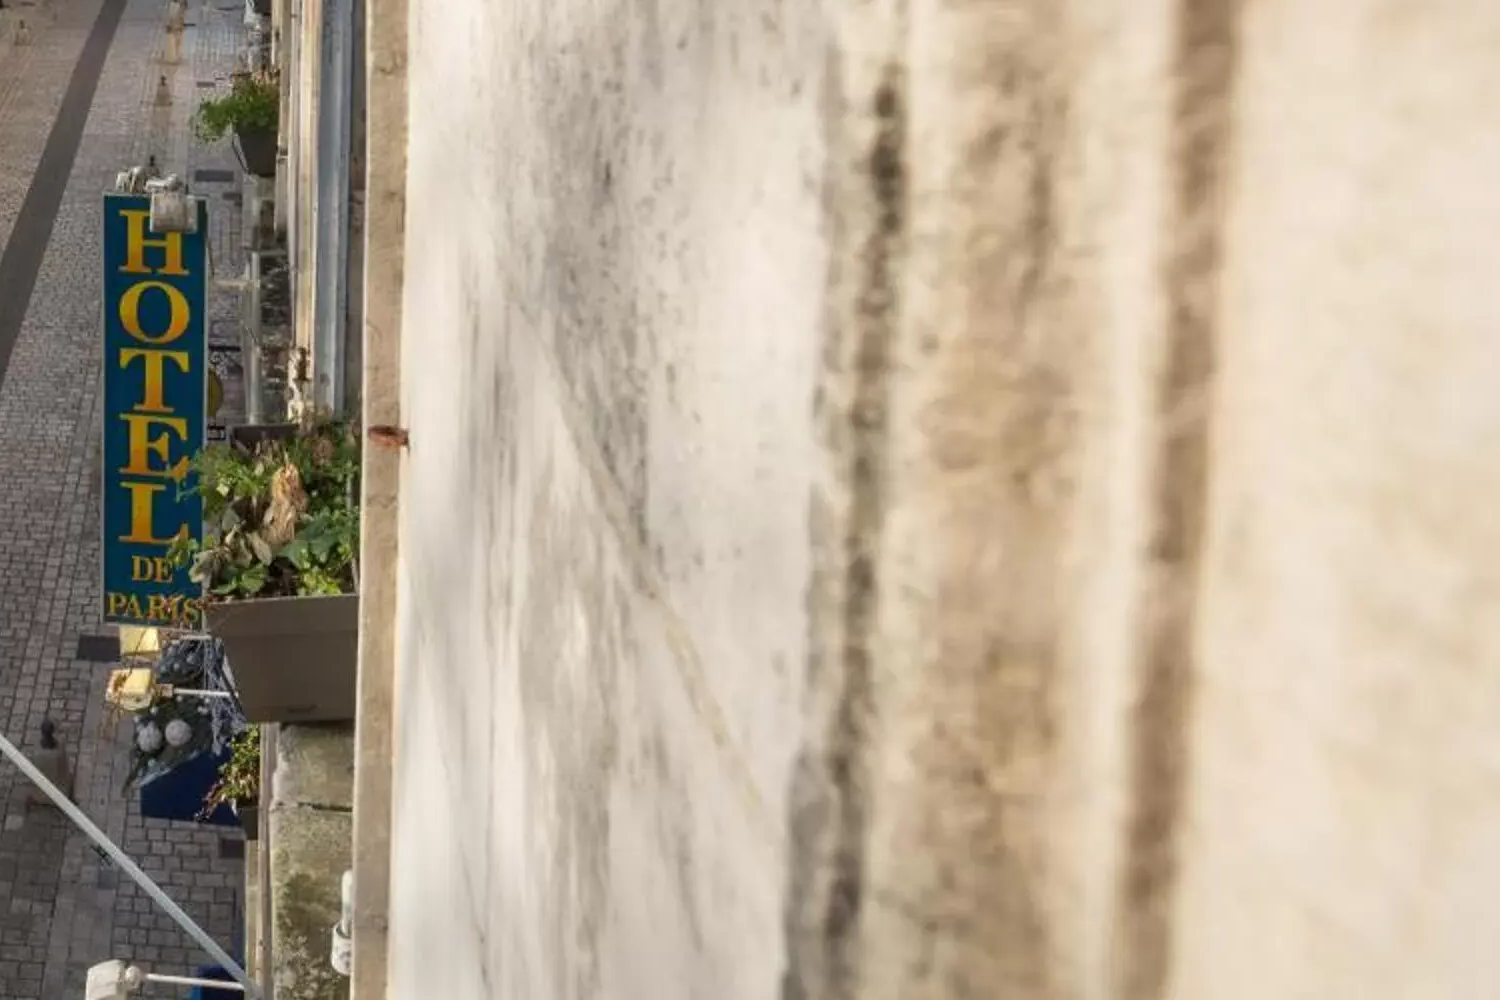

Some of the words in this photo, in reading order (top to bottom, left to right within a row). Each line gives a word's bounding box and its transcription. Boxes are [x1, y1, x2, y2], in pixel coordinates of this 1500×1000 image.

[118, 209, 190, 544] HOTEL
[131, 554, 173, 583] DE
[106, 592, 200, 624] PARIS
